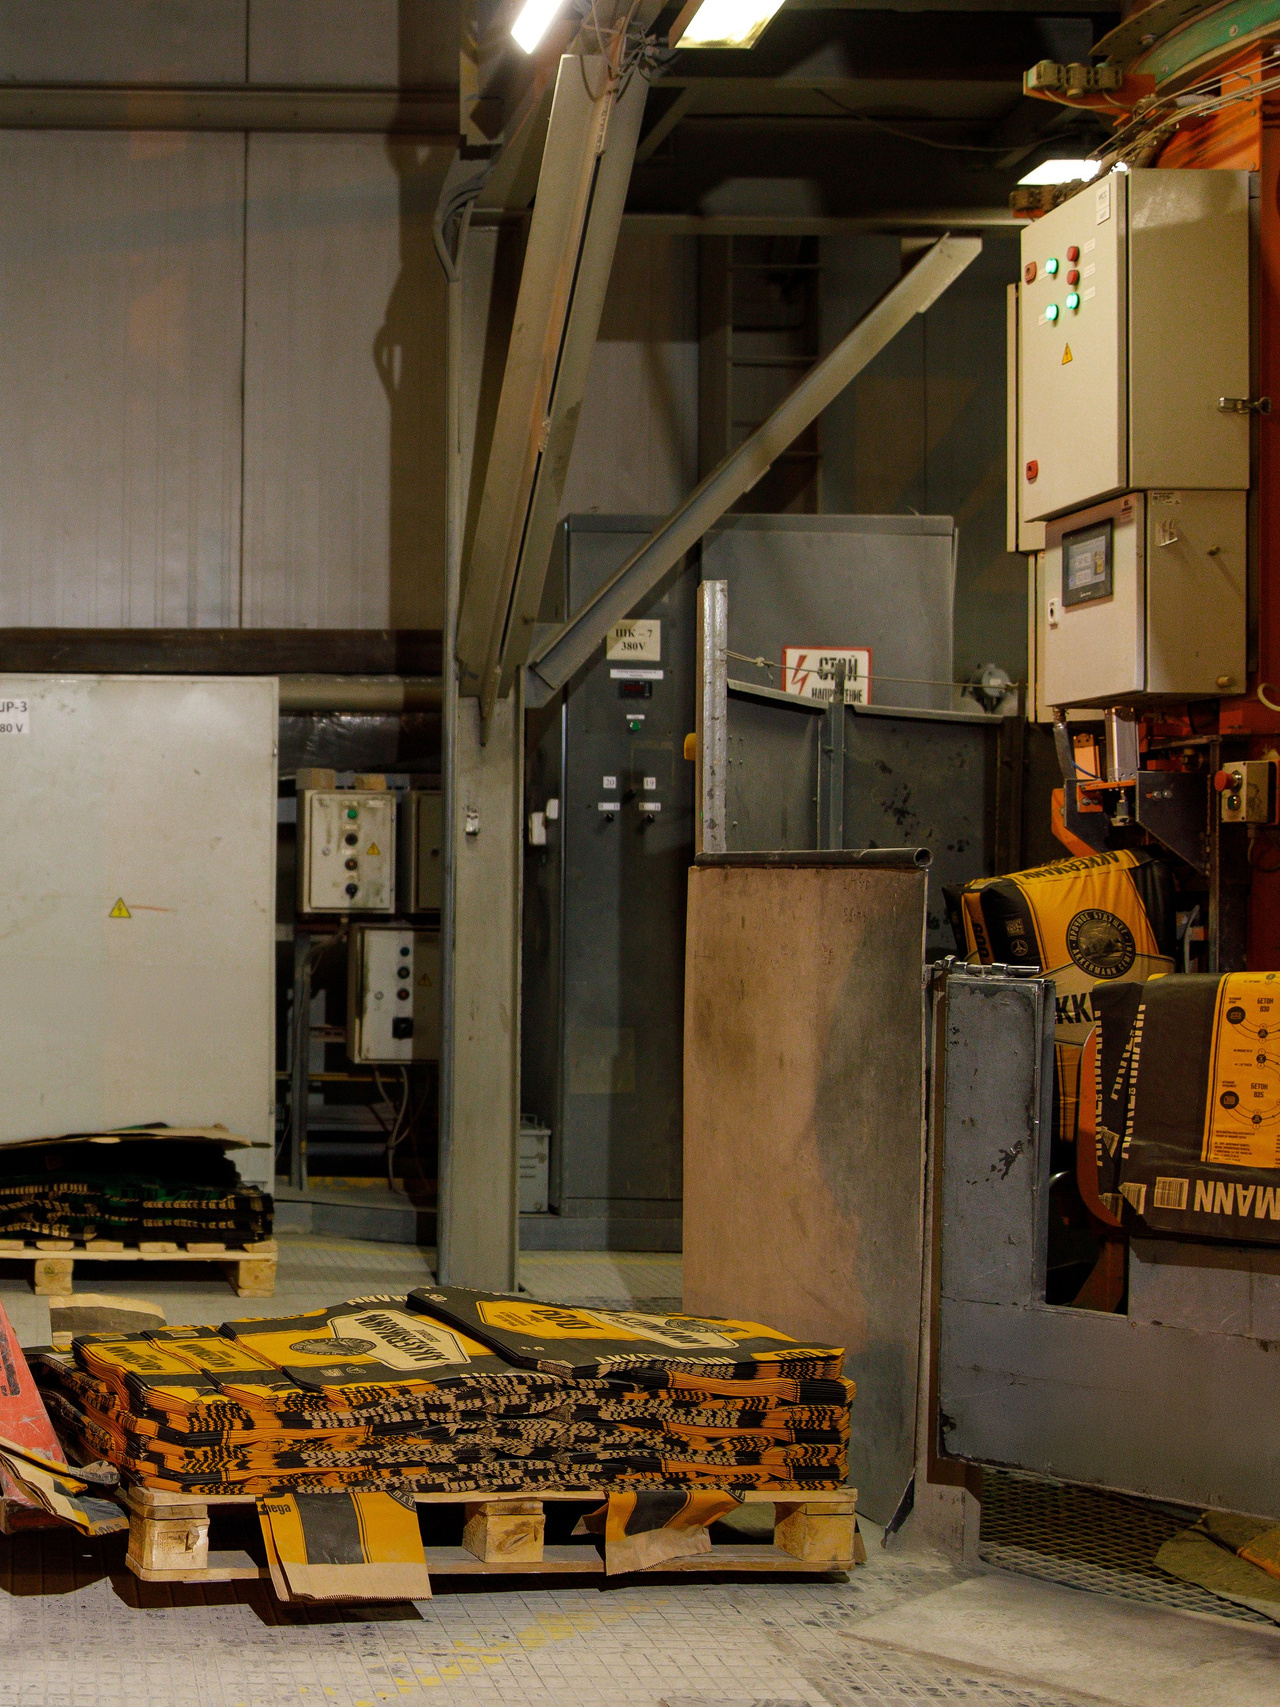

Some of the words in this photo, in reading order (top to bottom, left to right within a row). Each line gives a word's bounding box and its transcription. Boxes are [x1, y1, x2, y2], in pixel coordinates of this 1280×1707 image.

[615, 628, 635, 638] ШК
[621, 641, 645, 651] 380V
[15, 723, 24, 733] V
[606, 778, 616, 786] 20
[645, 779, 655, 787] 19
[1018, 852, 1120, 880] AKKERMANN
[1072, 948, 1117, 976] AKKERMANN
[1257, 997, 1274, 1005] БЕТОН
[1250, 1082, 1269, 1090] БЕТОН
[354, 1313, 451, 1362] AKKERMANN
